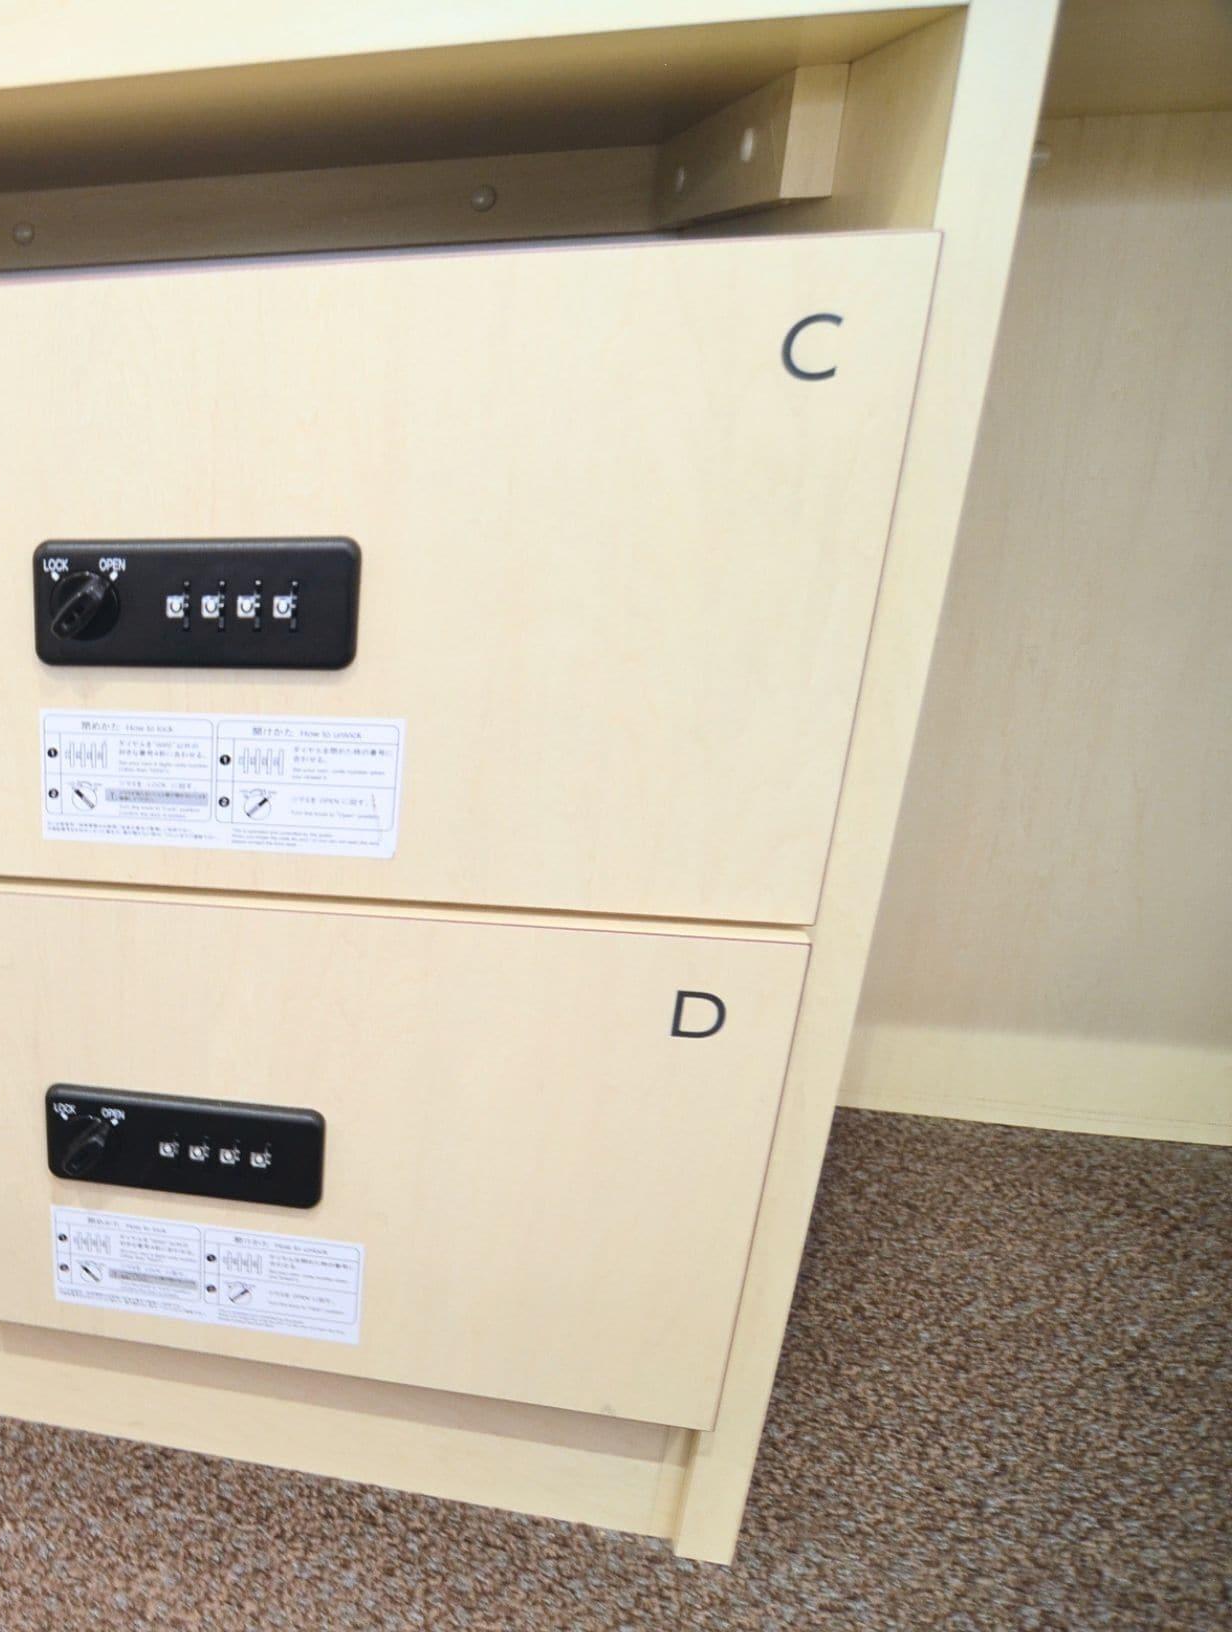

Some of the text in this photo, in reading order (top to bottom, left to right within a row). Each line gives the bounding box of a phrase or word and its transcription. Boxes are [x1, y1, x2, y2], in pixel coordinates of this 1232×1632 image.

[782, 312, 843, 381] C
[43, 558, 69, 572] LOCK
[99, 558, 126, 572] OPEN
[670, 990, 726, 1039] D
